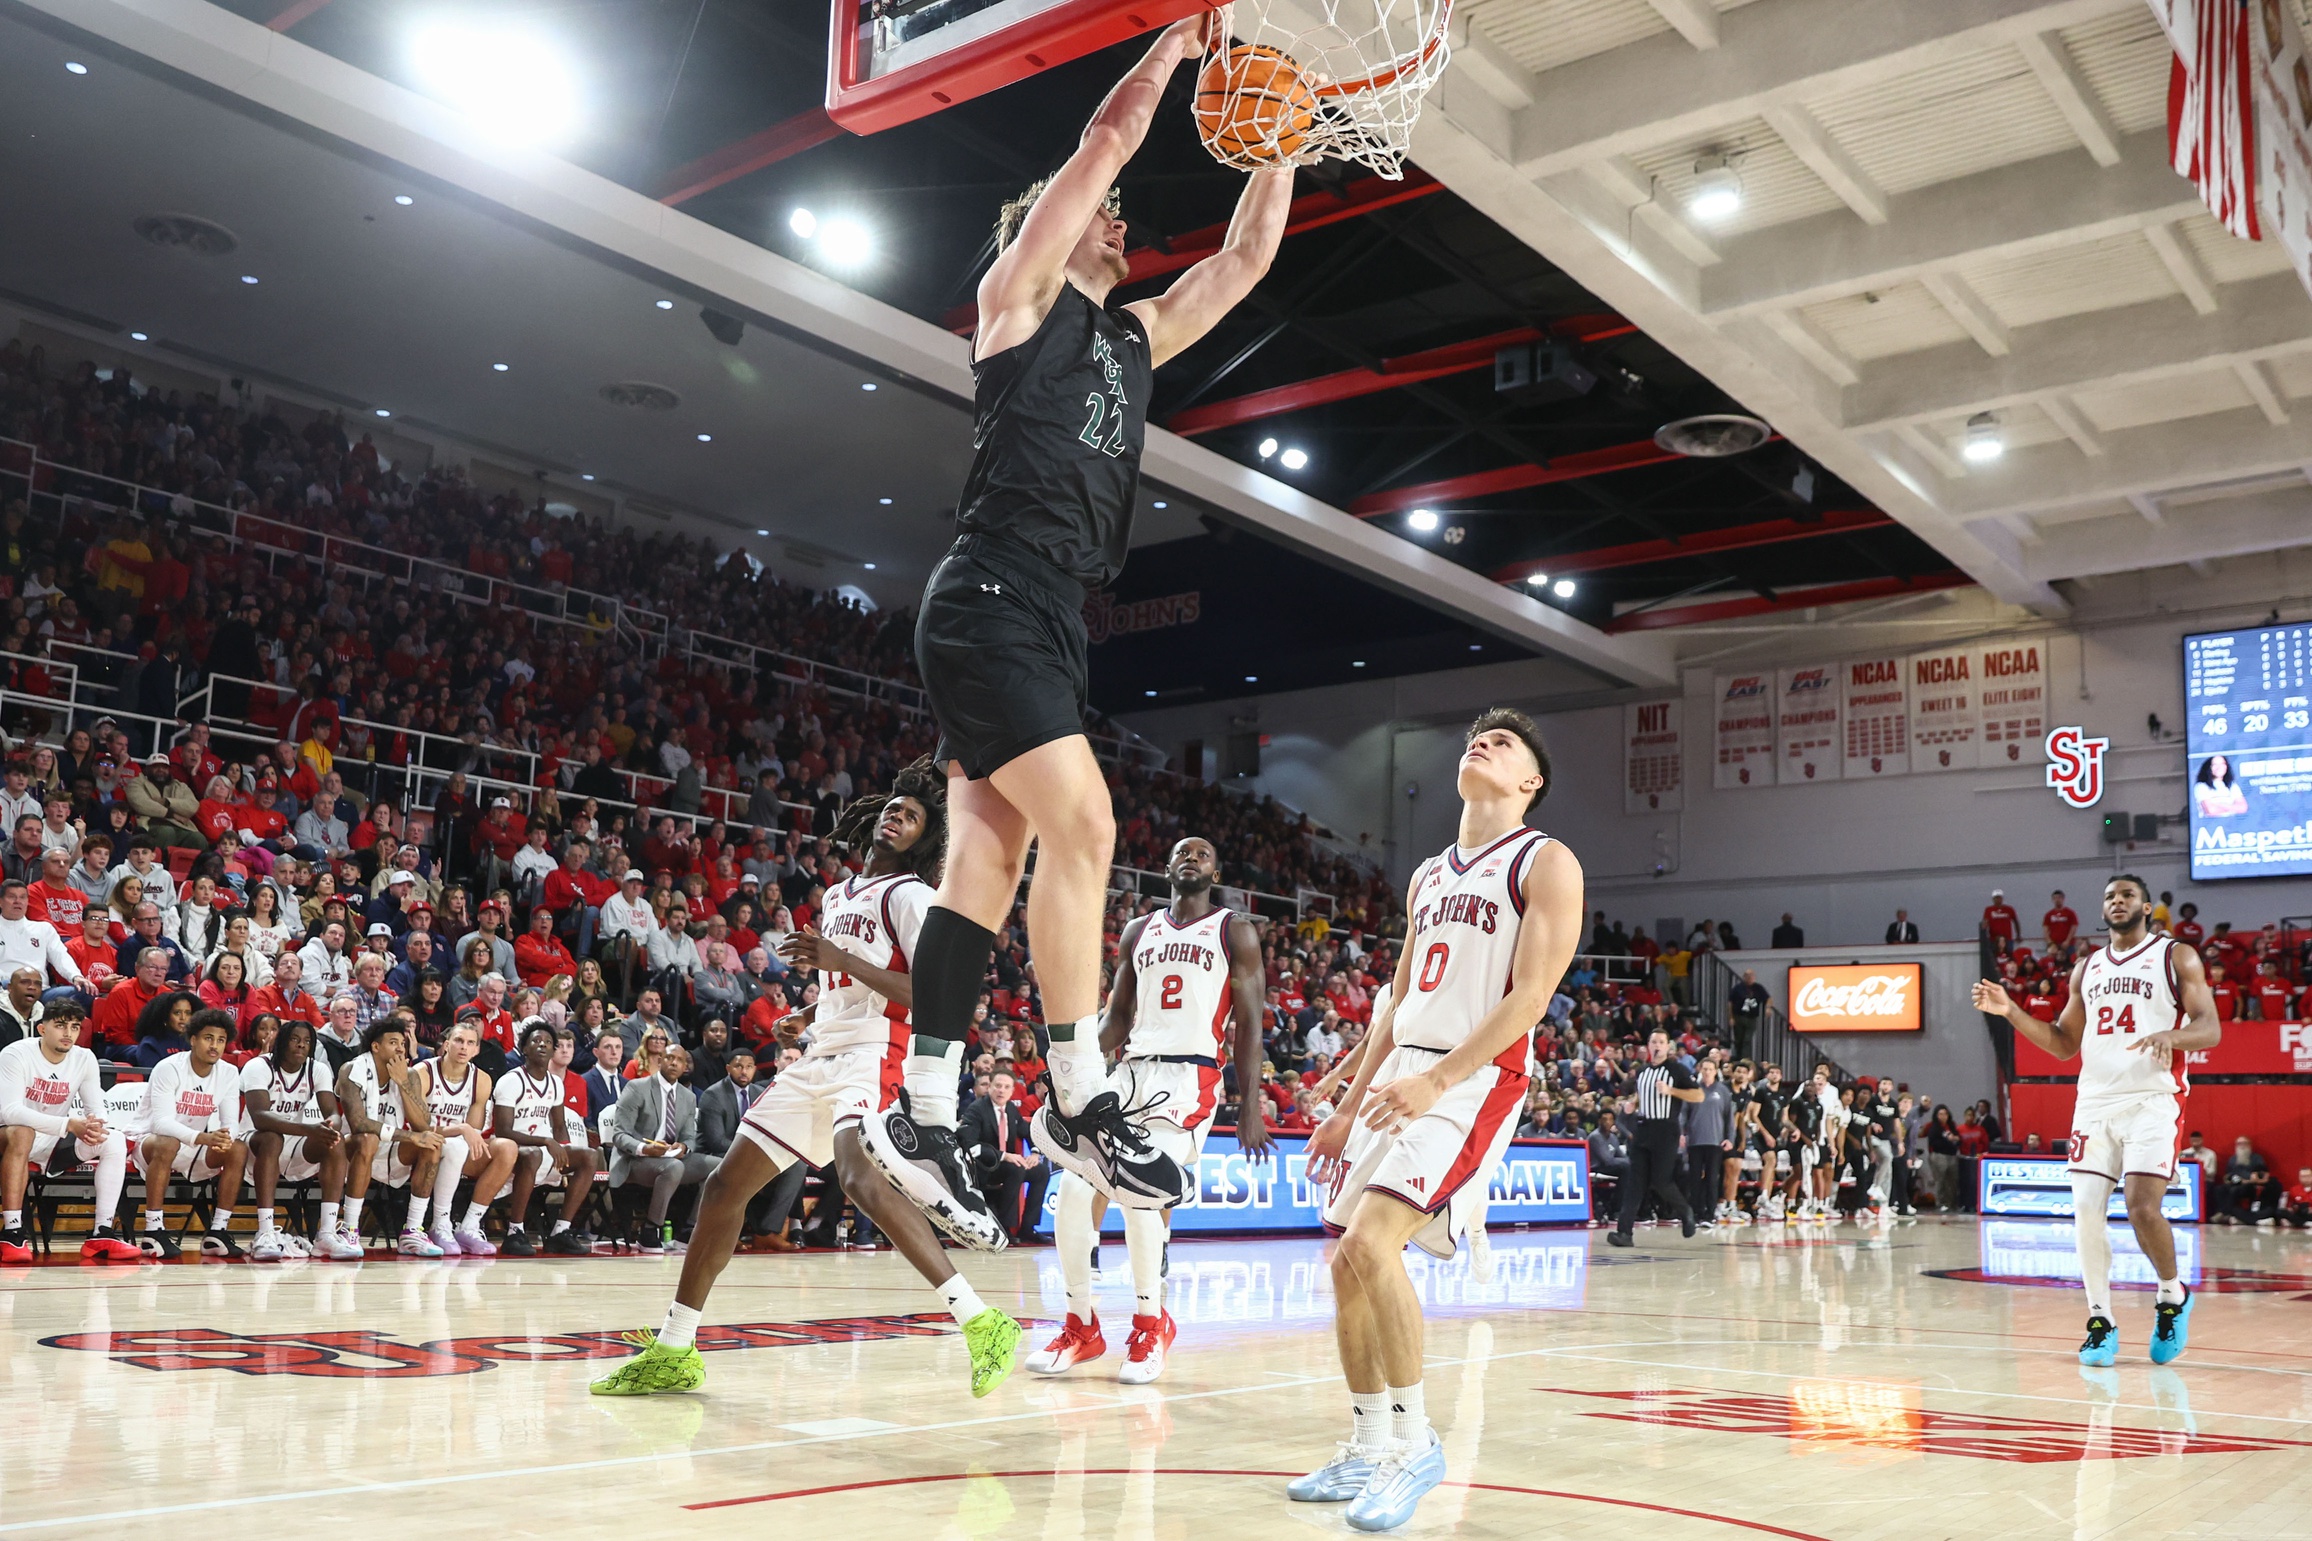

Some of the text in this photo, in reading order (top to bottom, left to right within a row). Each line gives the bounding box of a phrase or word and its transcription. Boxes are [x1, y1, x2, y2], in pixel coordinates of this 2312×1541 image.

[1079, 392, 1126, 458] 22
[1852, 660, 1897, 686] NCAA
[1916, 655, 1970, 685] NCAA
[1983, 647, 2040, 678] NCAA
[1726, 684, 1767, 698] EAST
[1789, 677, 1832, 692] EAST
[1982, 686, 2042, 707] ELITE EIGHT
[1637, 703, 1669, 733] NIT
[1718, 714, 1771, 733] CHAMPIONS
[1780, 709, 1837, 727] CHAMPIONS
[2202, 710, 2310, 736] 46 20 33
[2194, 853, 2261, 867] FEDERAL
[1432, 893, 1498, 935] JOHN'S
[829, 913, 877, 944] JOHN'S
[1137, 943, 1214, 973] ST. JOHN'S
[1418, 942, 1450, 992] 0
[1161, 974, 1183, 1010] 2
[2103, 976, 2153, 1000] JOHN'S
[2097, 1004, 2136, 1036] 24
[304, 1107, 321, 1119] ent
[593, 1173, 610, 1182] STOR
[1187, 1154, 1278, 1208] EST
[1487, 1160, 1584, 1206] RAVEL
